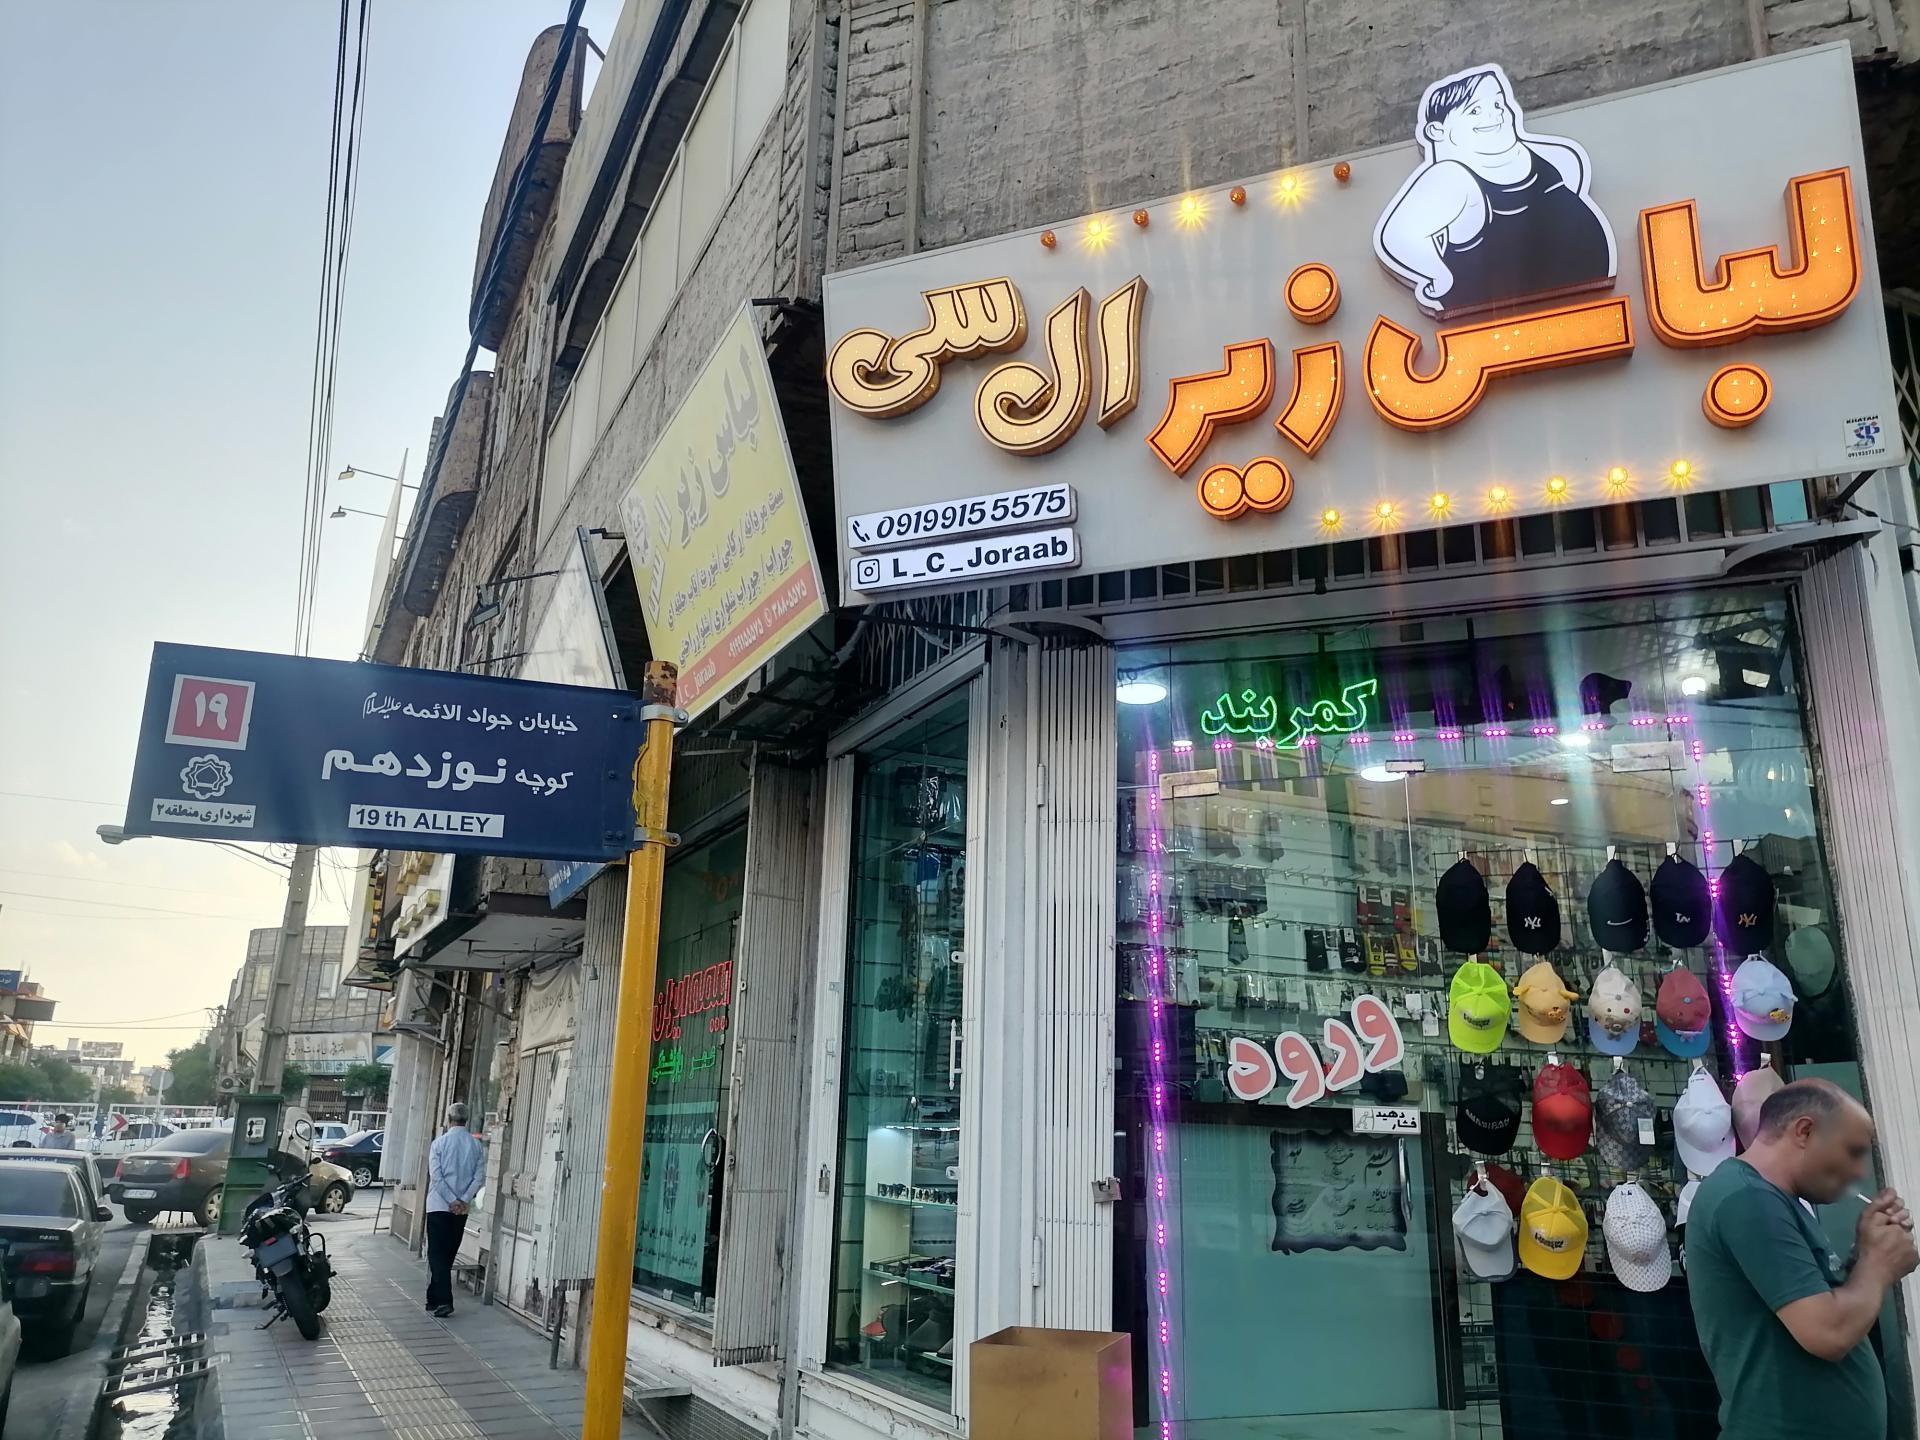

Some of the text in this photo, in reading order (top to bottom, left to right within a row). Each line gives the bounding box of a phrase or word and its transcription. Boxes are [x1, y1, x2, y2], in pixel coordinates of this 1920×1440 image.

[1363, 166, 1863, 431] لباس
[1145, 263, 1345, 520] زیر
[708, 343, 762, 499] لباس
[676, 447, 710, 549] زیر
[876, 487, 1066, 539] 09199155575
[765, 539, 793, 580] جوراب
[195, 690, 229, 731] ۱۹
[402, 702, 461, 721] الائمه
[467, 707, 513, 731] جواد
[519, 712, 578, 735] خیابان
[321, 744, 574, 796] کوچه نوزدهم
[157, 803, 252, 824] شهرداری منطقه ۲
[413, 812, 491, 833] ALLEY
[1228, 994, 1404, 1109] ورود
[1375, 1110, 1405, 1121] دهید
[1391, 1117, 1417, 1130] فشار
